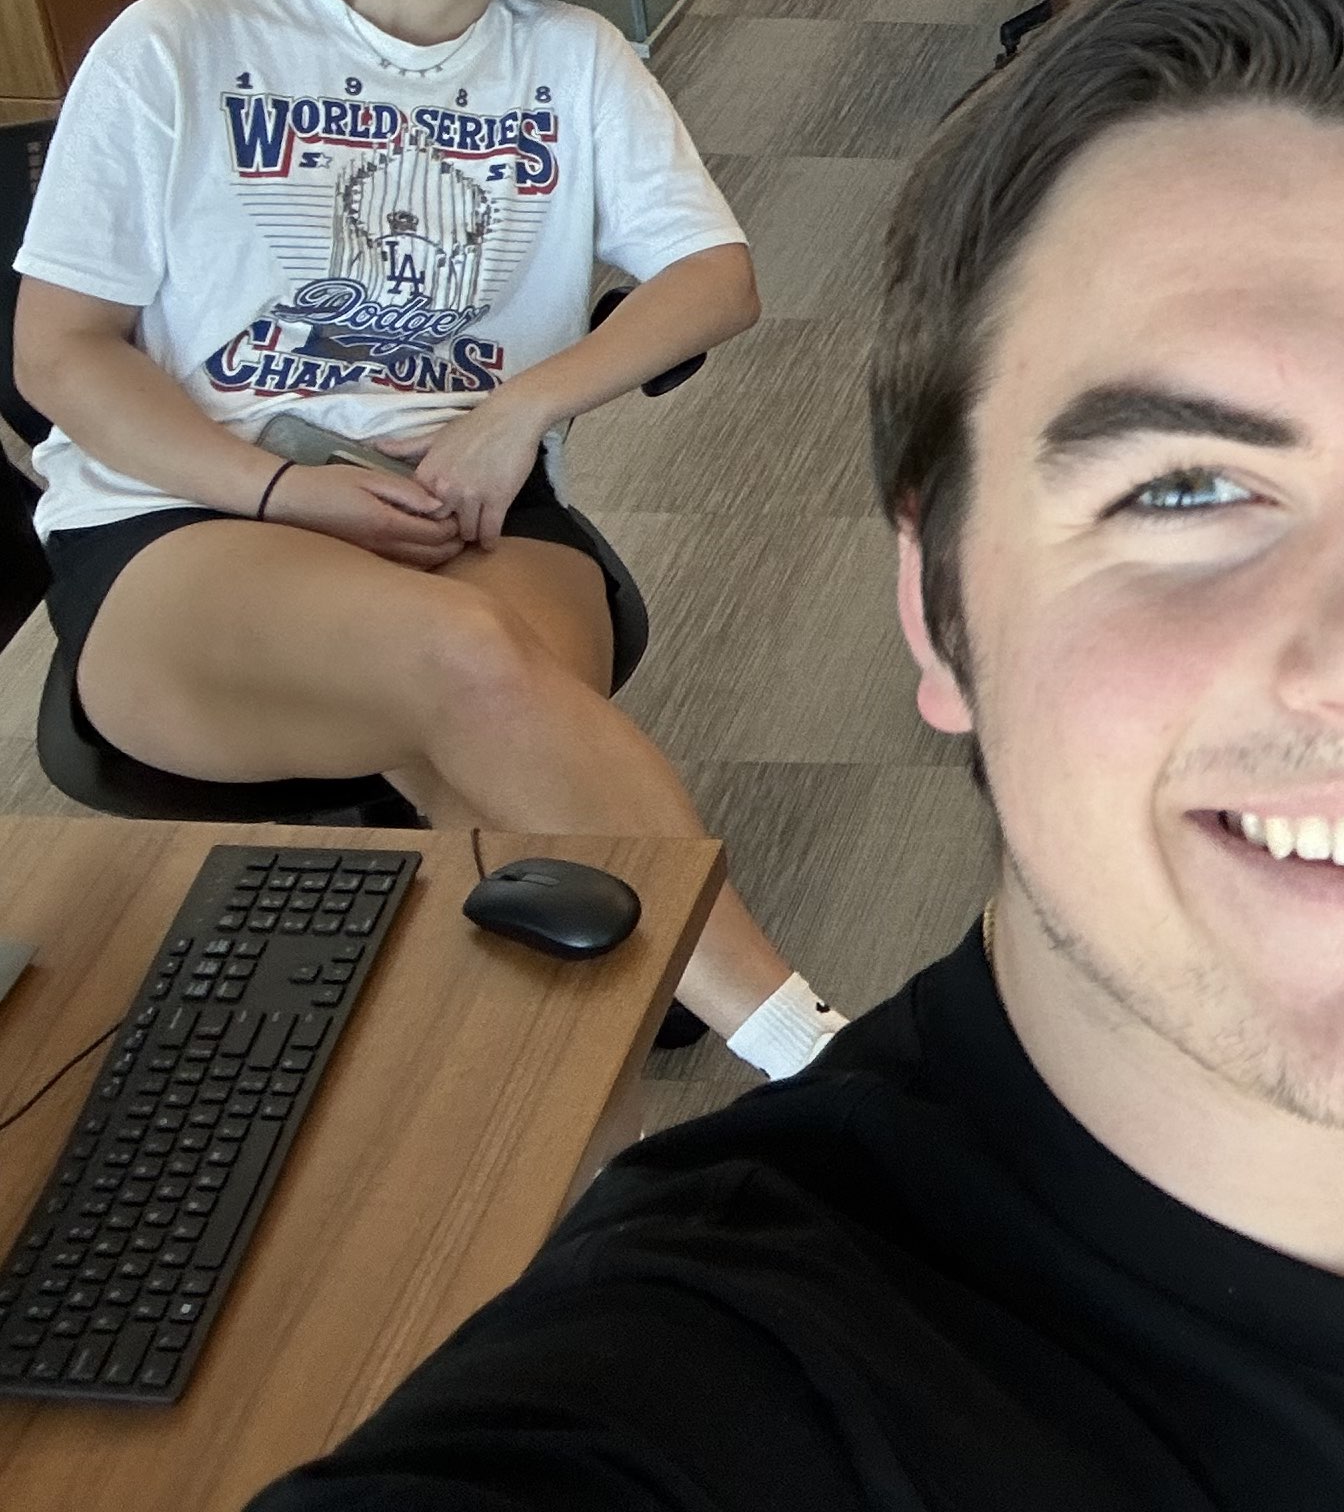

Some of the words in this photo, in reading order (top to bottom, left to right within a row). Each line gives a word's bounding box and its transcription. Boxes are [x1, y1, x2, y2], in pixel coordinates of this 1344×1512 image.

[221, 91, 408, 177] WORLD
[412, 106, 559, 195] SERIES
[384, 240, 426, 296] LA
